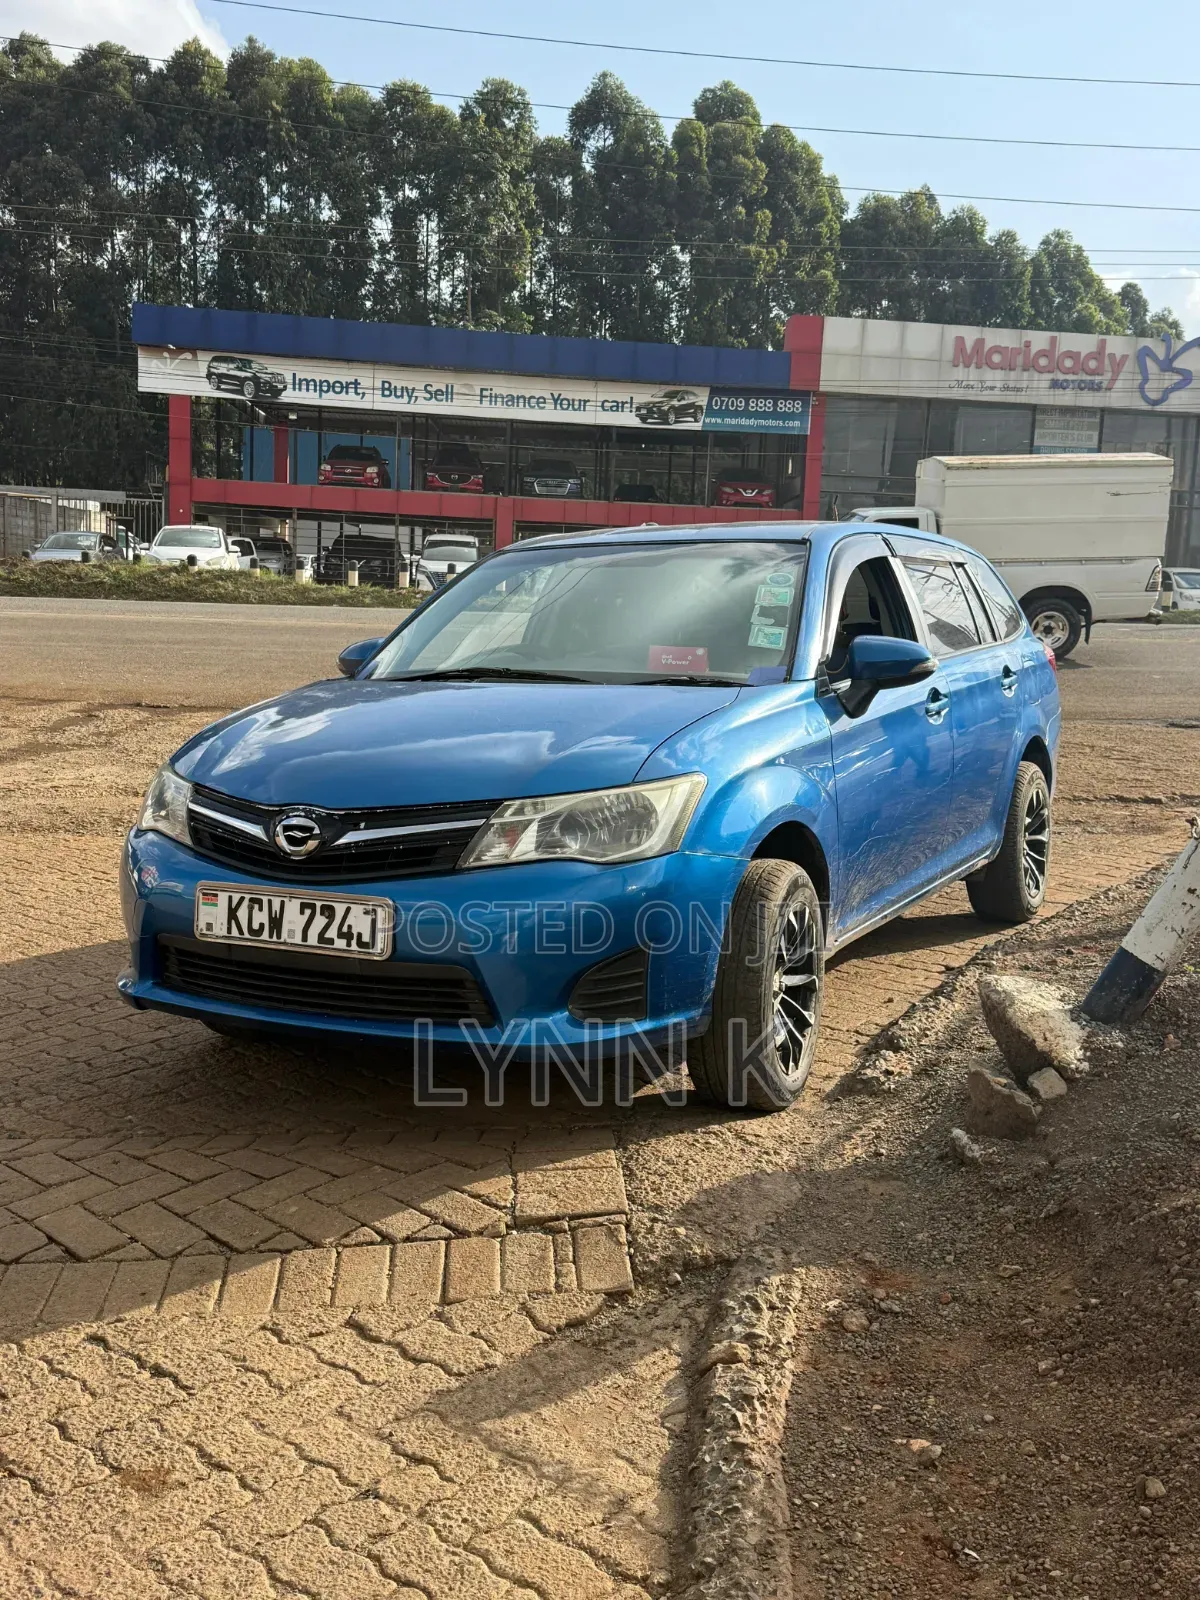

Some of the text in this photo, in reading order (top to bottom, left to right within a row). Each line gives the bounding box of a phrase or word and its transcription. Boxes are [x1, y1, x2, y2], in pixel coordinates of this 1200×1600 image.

[951, 335, 1129, 391] Maridady
[291, 372, 454, 404] Import, Buy, Sell
[979, 381, 998, 392] Your
[1049, 378, 1103, 392] MOTORS
[478, 387, 634, 413] Finance Your car!
[712, 397, 802, 413] 0709 888 888
[704, 416, 801, 428] www.maridadymotors.com
[226, 895, 285, 940] KCW
[300, 902, 377, 949] 724J
